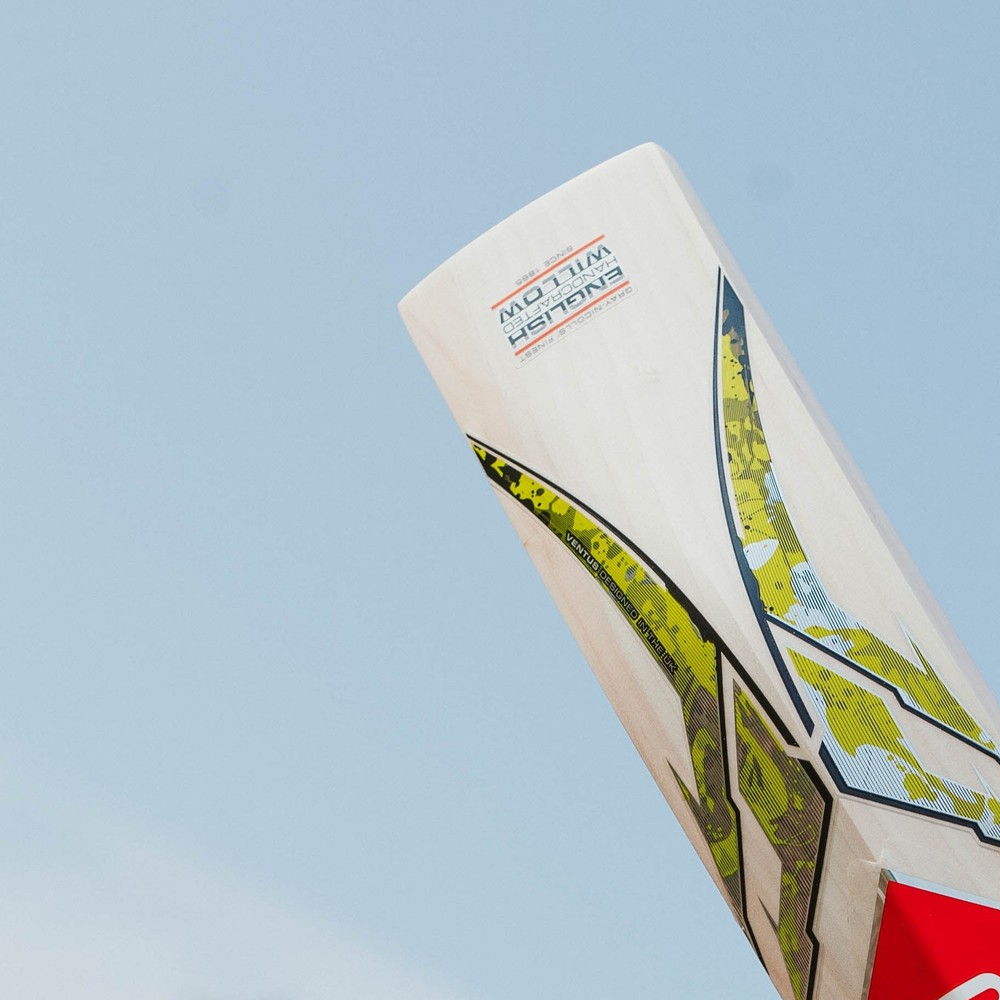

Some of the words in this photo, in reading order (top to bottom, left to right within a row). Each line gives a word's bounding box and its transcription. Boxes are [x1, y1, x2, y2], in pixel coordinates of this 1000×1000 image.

[499, 243, 612, 324] WILLOW
[502, 256, 618, 335] HANDCRAFTED
[507, 265, 625, 349] ENGLISH
[520, 337, 554, 363] FINEST
[566, 532, 600, 571] VENTUS
[599, 570, 639, 620] DESIGNED
[637, 619, 649, 633] IN
[648, 631, 664, 655] THE
[663, 653, 678, 674] UK
